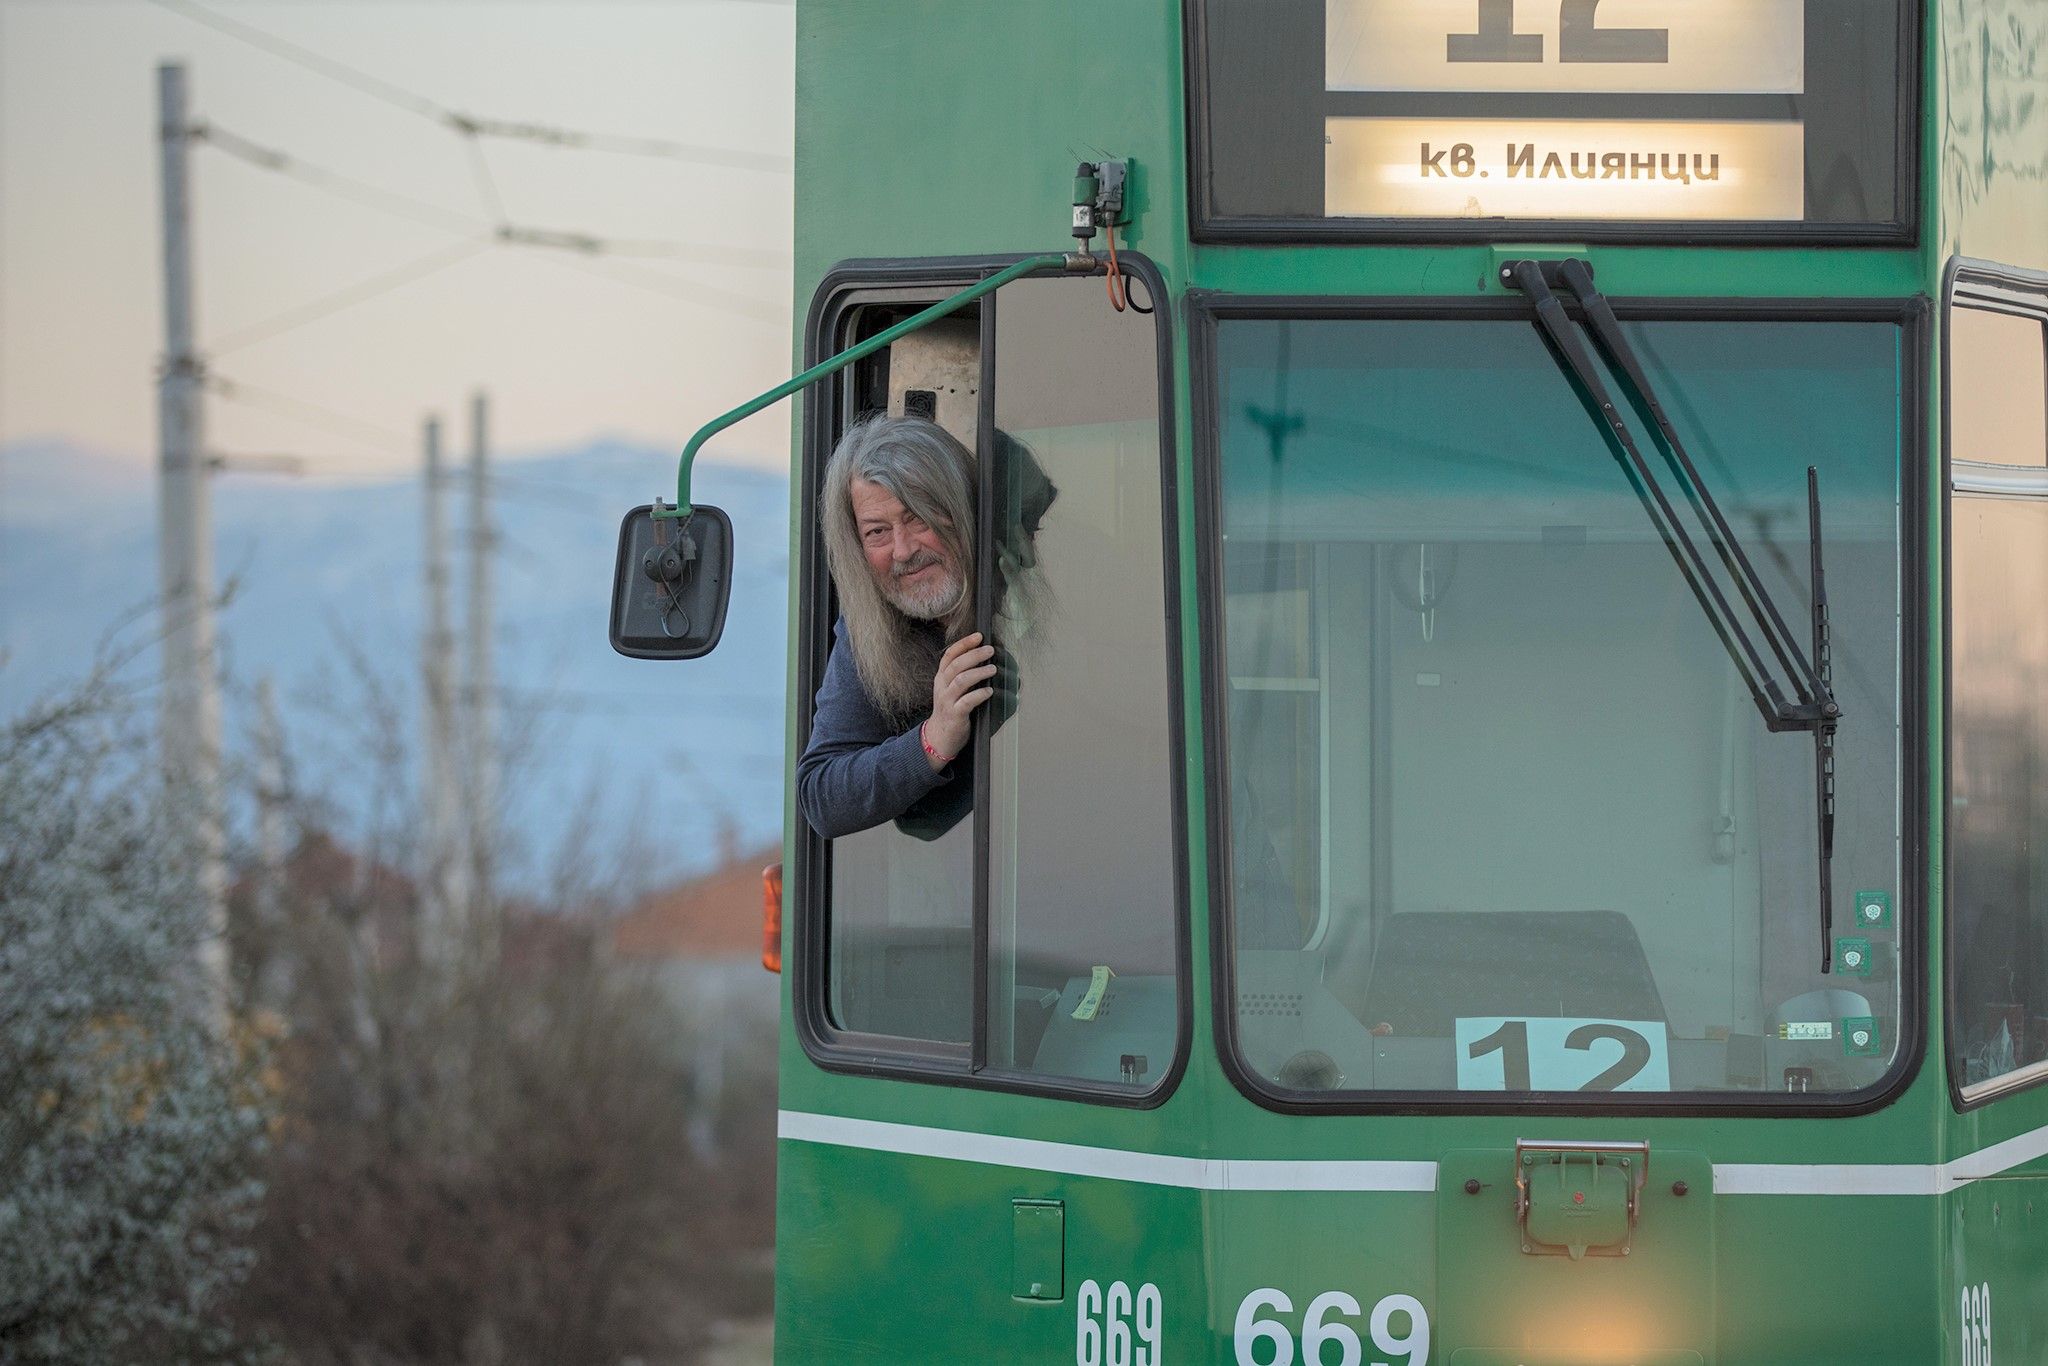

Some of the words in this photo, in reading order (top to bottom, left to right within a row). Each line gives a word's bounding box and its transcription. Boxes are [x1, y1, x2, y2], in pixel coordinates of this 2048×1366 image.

[1421, 142, 1489, 178] кв.
[1506, 143, 1719, 185] Илиянци
[1469, 1021, 1651, 1091] 12
[1076, 1279, 1162, 1366] 669
[1234, 1287, 1430, 1366] 669
[1961, 1281, 1991, 1366] 669
